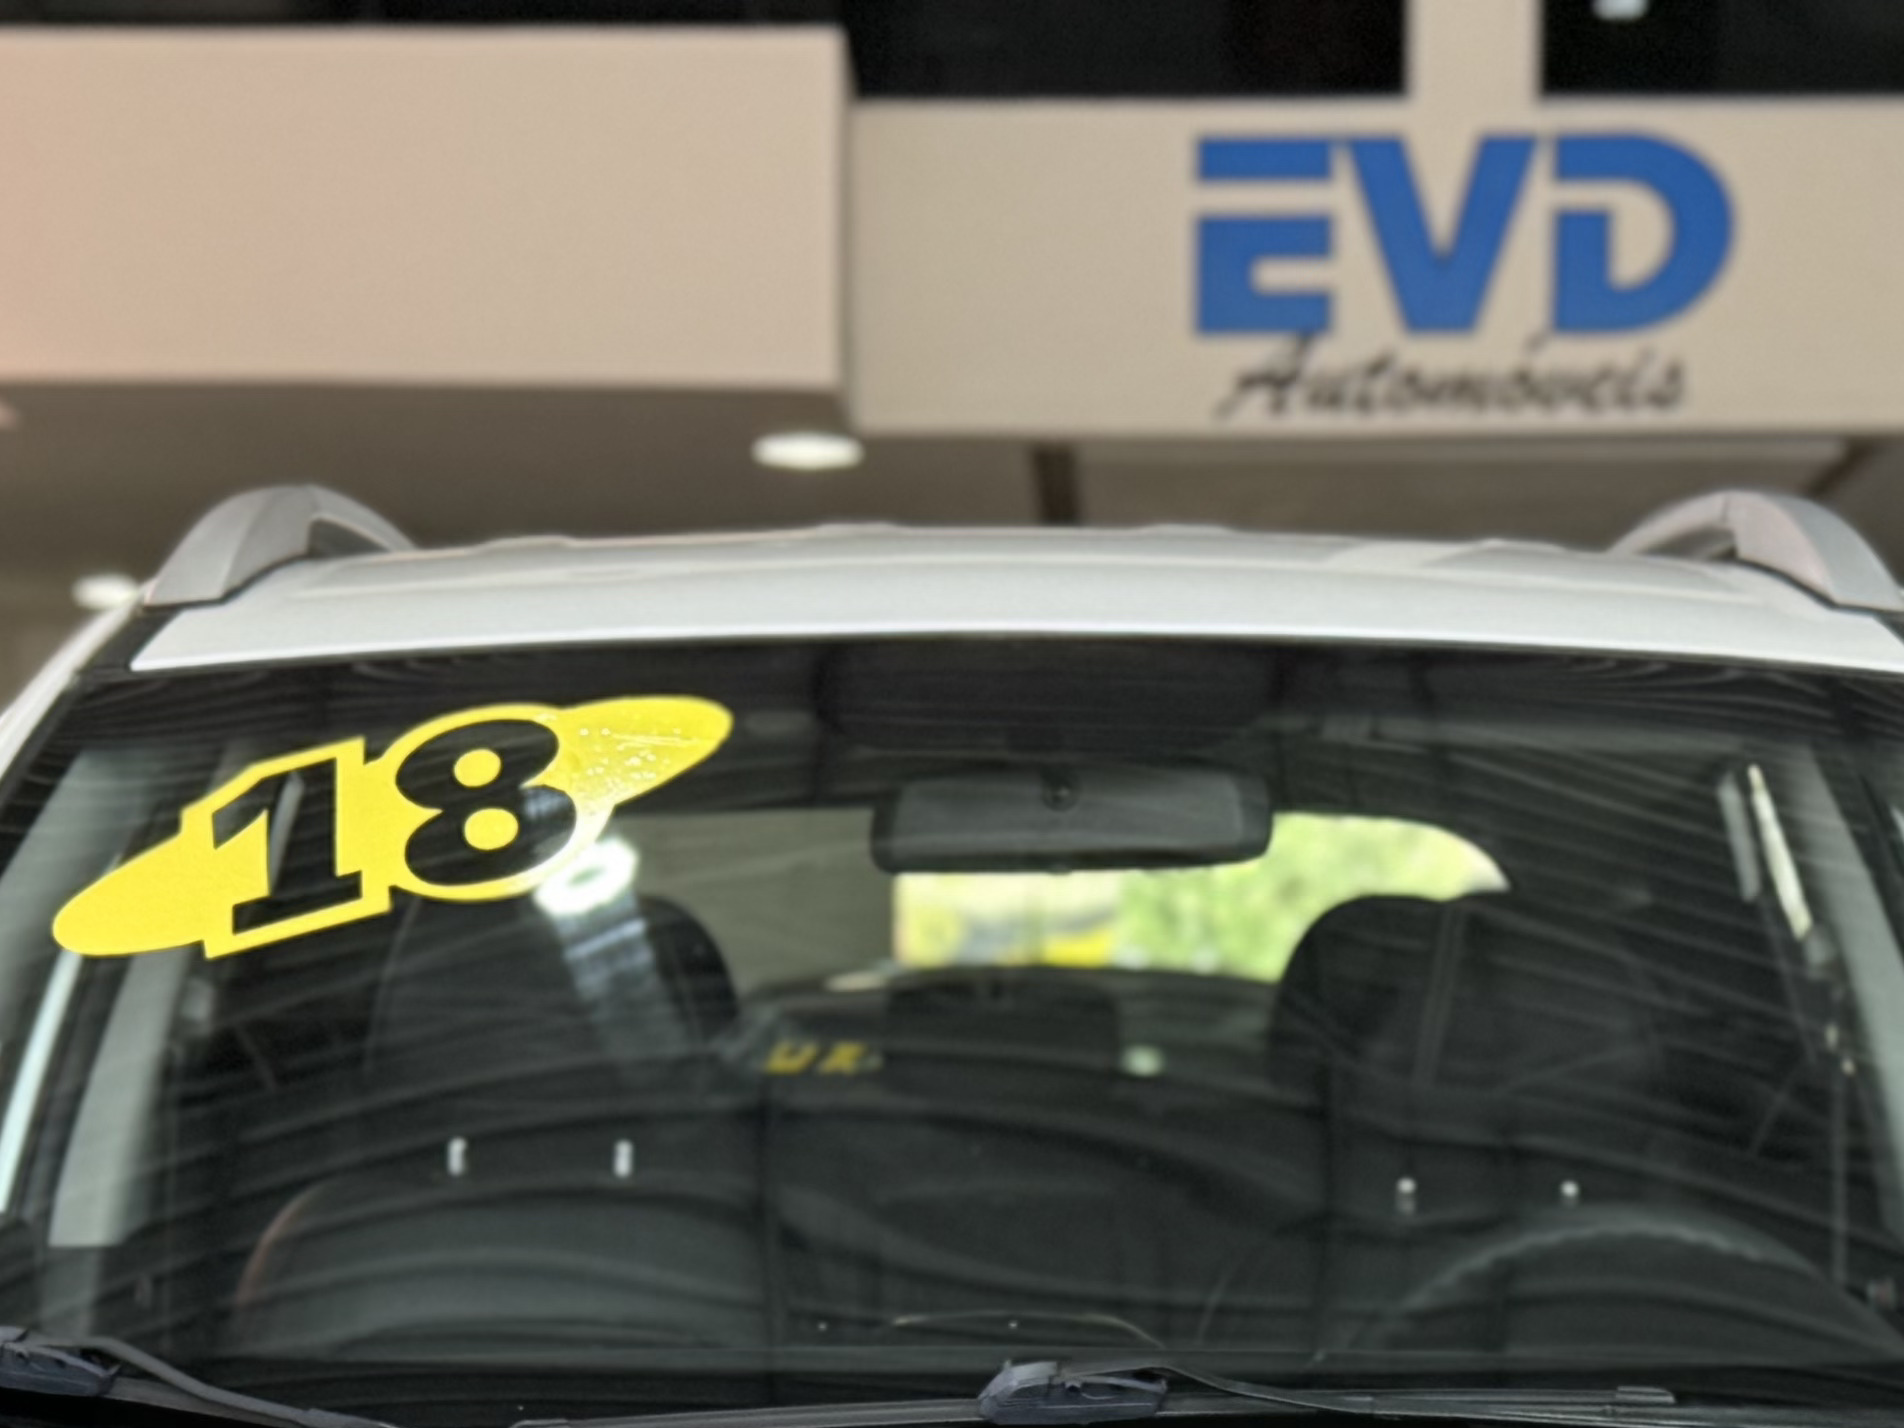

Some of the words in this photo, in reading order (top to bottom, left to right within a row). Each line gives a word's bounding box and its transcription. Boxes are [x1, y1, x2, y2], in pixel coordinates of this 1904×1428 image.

[1195, 133, 1734, 333] EVD
[1216, 328, 1684, 418] Automóveis
[212, 718, 578, 937] 18
